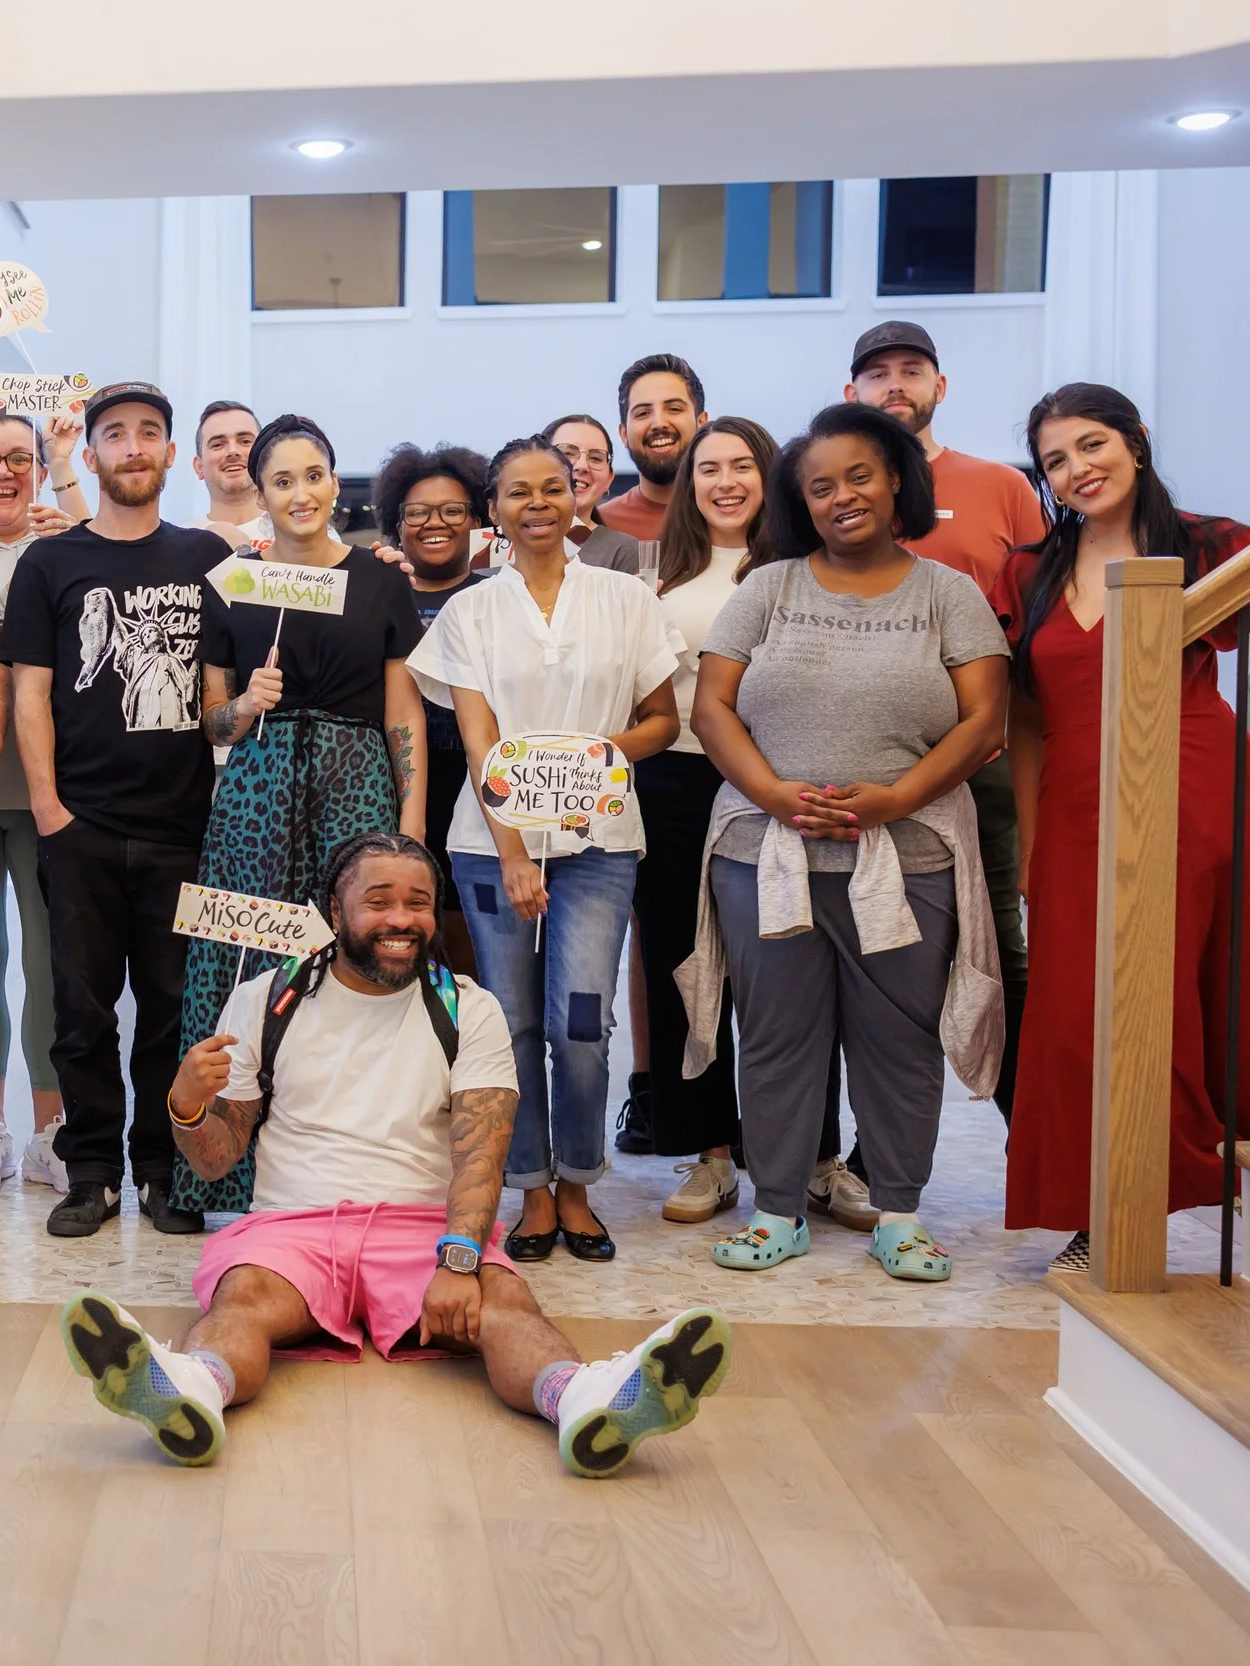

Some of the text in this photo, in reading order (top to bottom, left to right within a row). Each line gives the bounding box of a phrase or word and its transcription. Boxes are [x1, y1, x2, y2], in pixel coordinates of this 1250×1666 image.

[6, 270, 27, 284] See
[6, 287, 27, 304] Me
[2, 377, 67, 394] Chop Stick
[7, 395, 61, 412] MASTER
[261, 567, 336, 585] Can't Handle
[124, 582, 203, 614] WORKING
[167, 612, 201, 635] CLAS
[773, 605, 928, 633] Sassenach
[528, 750, 586, 766] I Wonder If
[569, 767, 603, 783] Thinks
[571, 781, 603, 792] About
[514, 789, 595, 813] ME TOO
